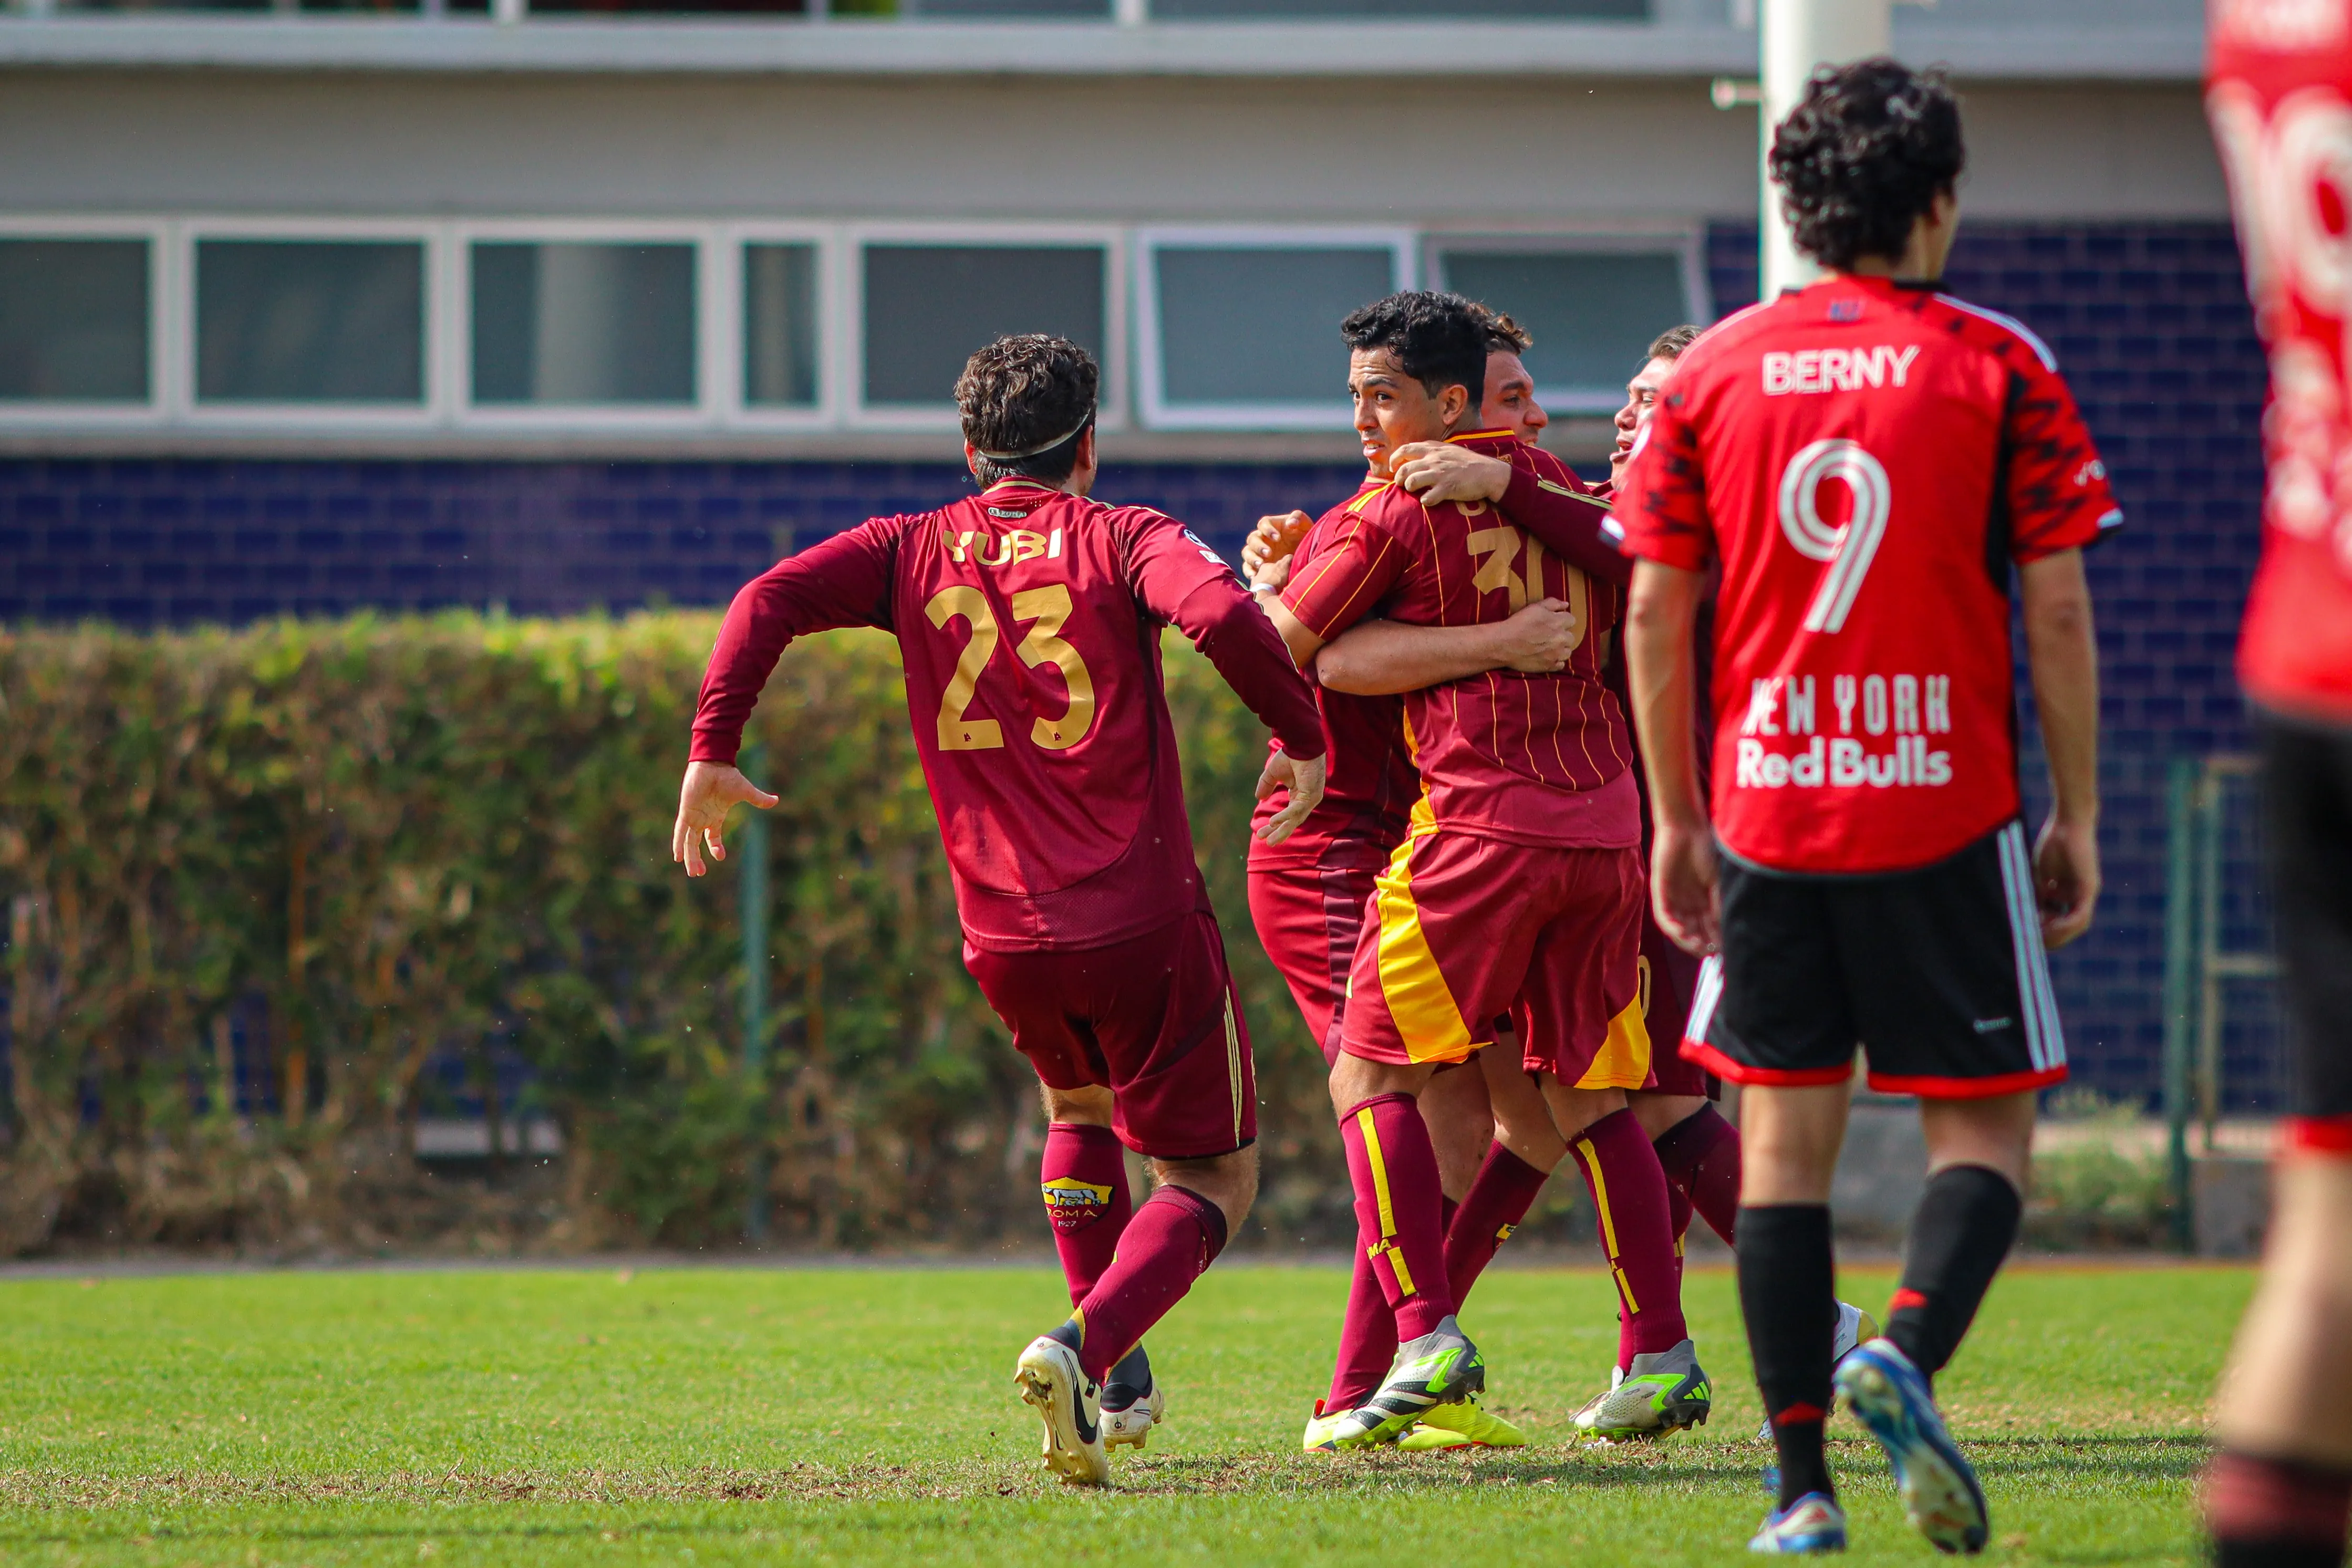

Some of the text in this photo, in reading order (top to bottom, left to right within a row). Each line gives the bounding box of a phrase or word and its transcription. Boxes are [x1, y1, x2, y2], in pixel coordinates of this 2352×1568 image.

[1762, 345, 1921, 396] BERNY
[941, 528, 1061, 566] YUBI
[1778, 438, 1891, 634] 9
[924, 584, 1094, 751] 23
[1740, 674, 1952, 736] NEW YORK
[1736, 735, 1953, 788] Red Bulls
[1047, 1207, 1097, 1218] ROMA
